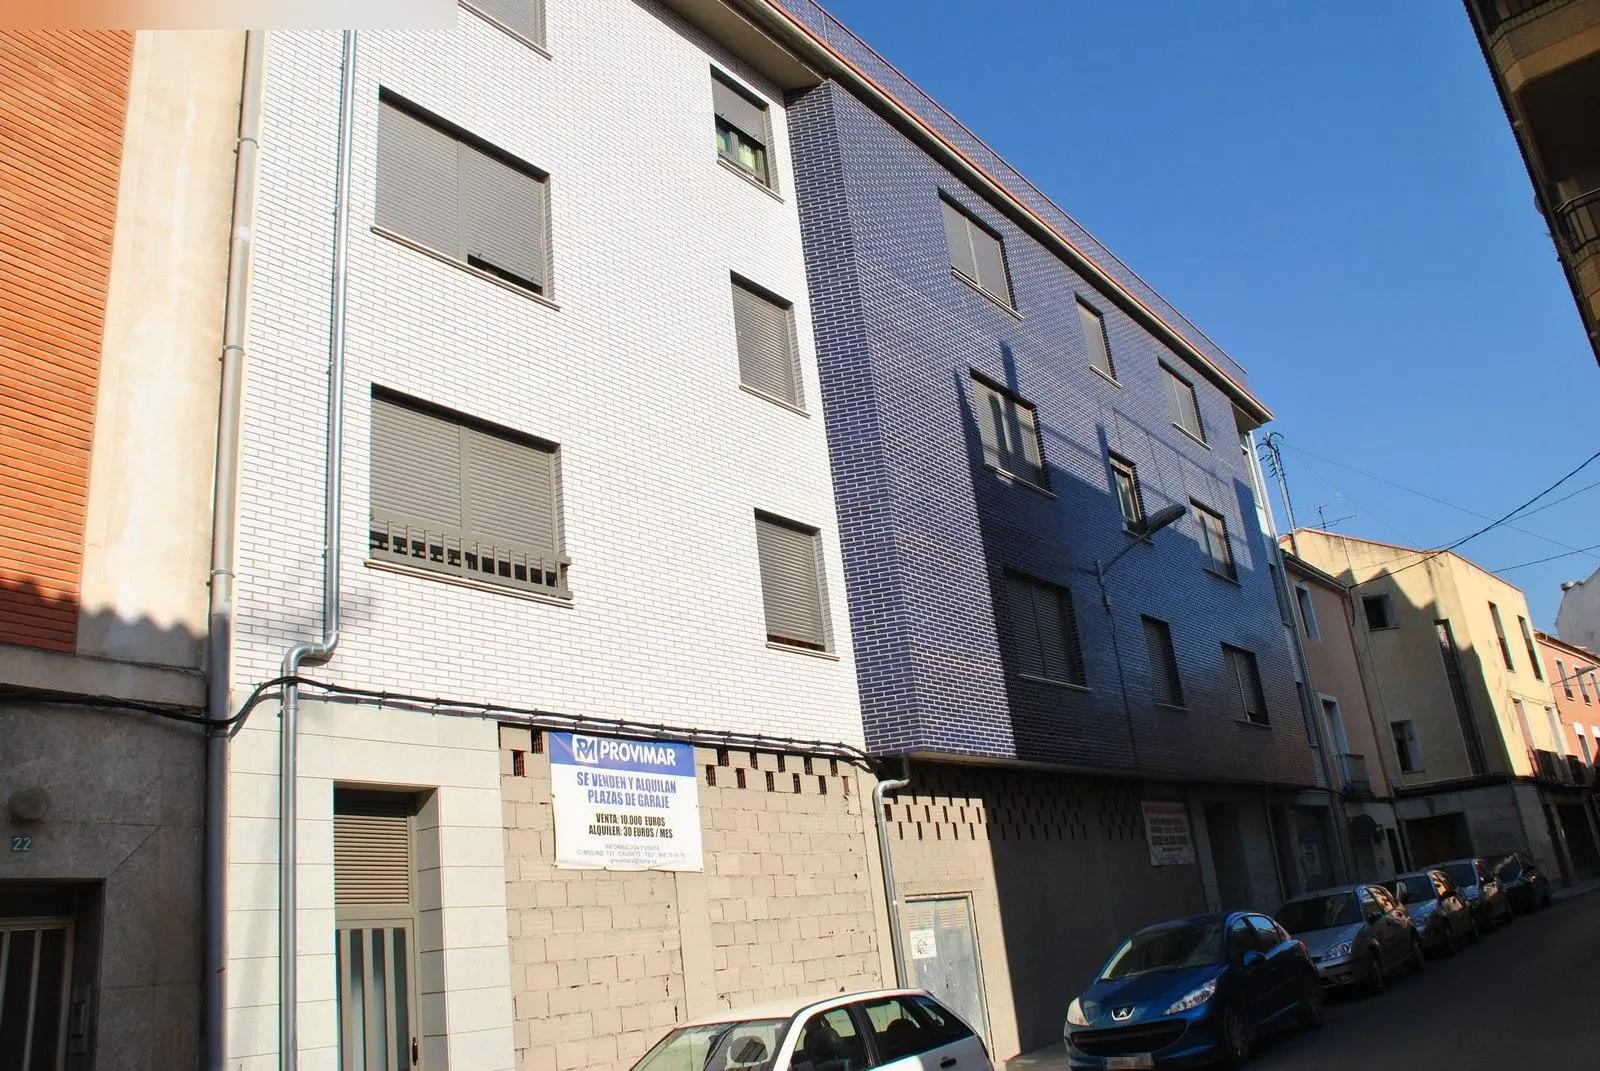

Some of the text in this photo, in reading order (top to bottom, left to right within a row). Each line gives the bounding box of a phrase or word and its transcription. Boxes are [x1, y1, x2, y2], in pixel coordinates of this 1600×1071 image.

[600, 741, 676, 766] PROVIMAR
[577, 772, 677, 794] SE VENDEN Y ALQUILAN
[588, 790, 670, 809] PLAZAS DE GARAJE
[596, 813, 666, 827] VENTA: 10.000 EUROS
[589, 825, 622, 836] ALQUILER:
[623, 826, 632, 837] 30
[633, 827, 655, 838] EUROS
[660, 828, 673, 839] MES
[14, 837, 31, 850] 22
